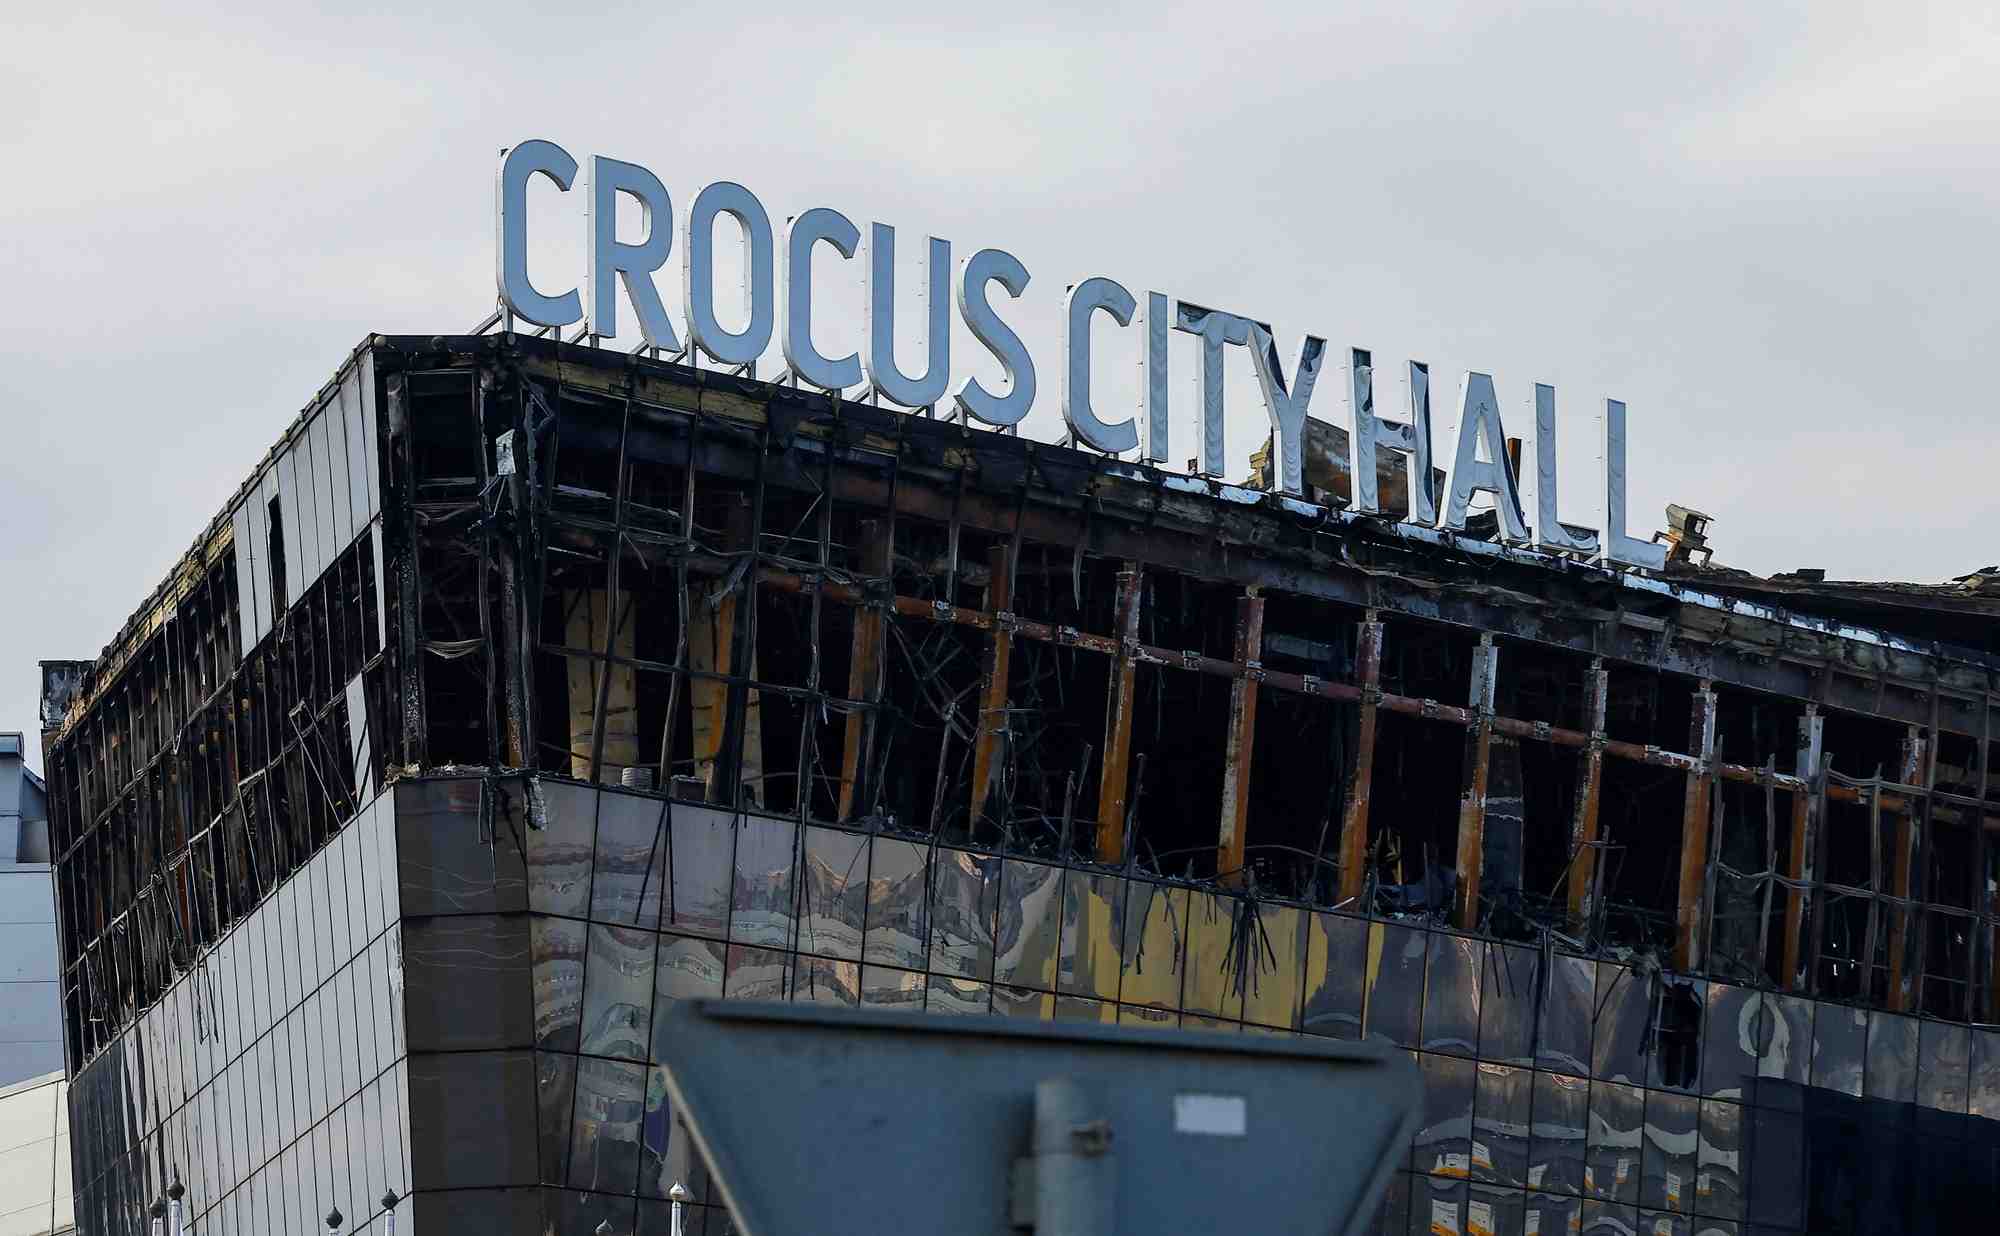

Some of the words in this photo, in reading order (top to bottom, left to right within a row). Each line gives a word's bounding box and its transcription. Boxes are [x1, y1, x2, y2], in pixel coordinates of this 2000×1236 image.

[497, 139, 1036, 425] CROCUS
[1062, 276, 1328, 497] CITY
[1345, 346, 1668, 572] HALL
